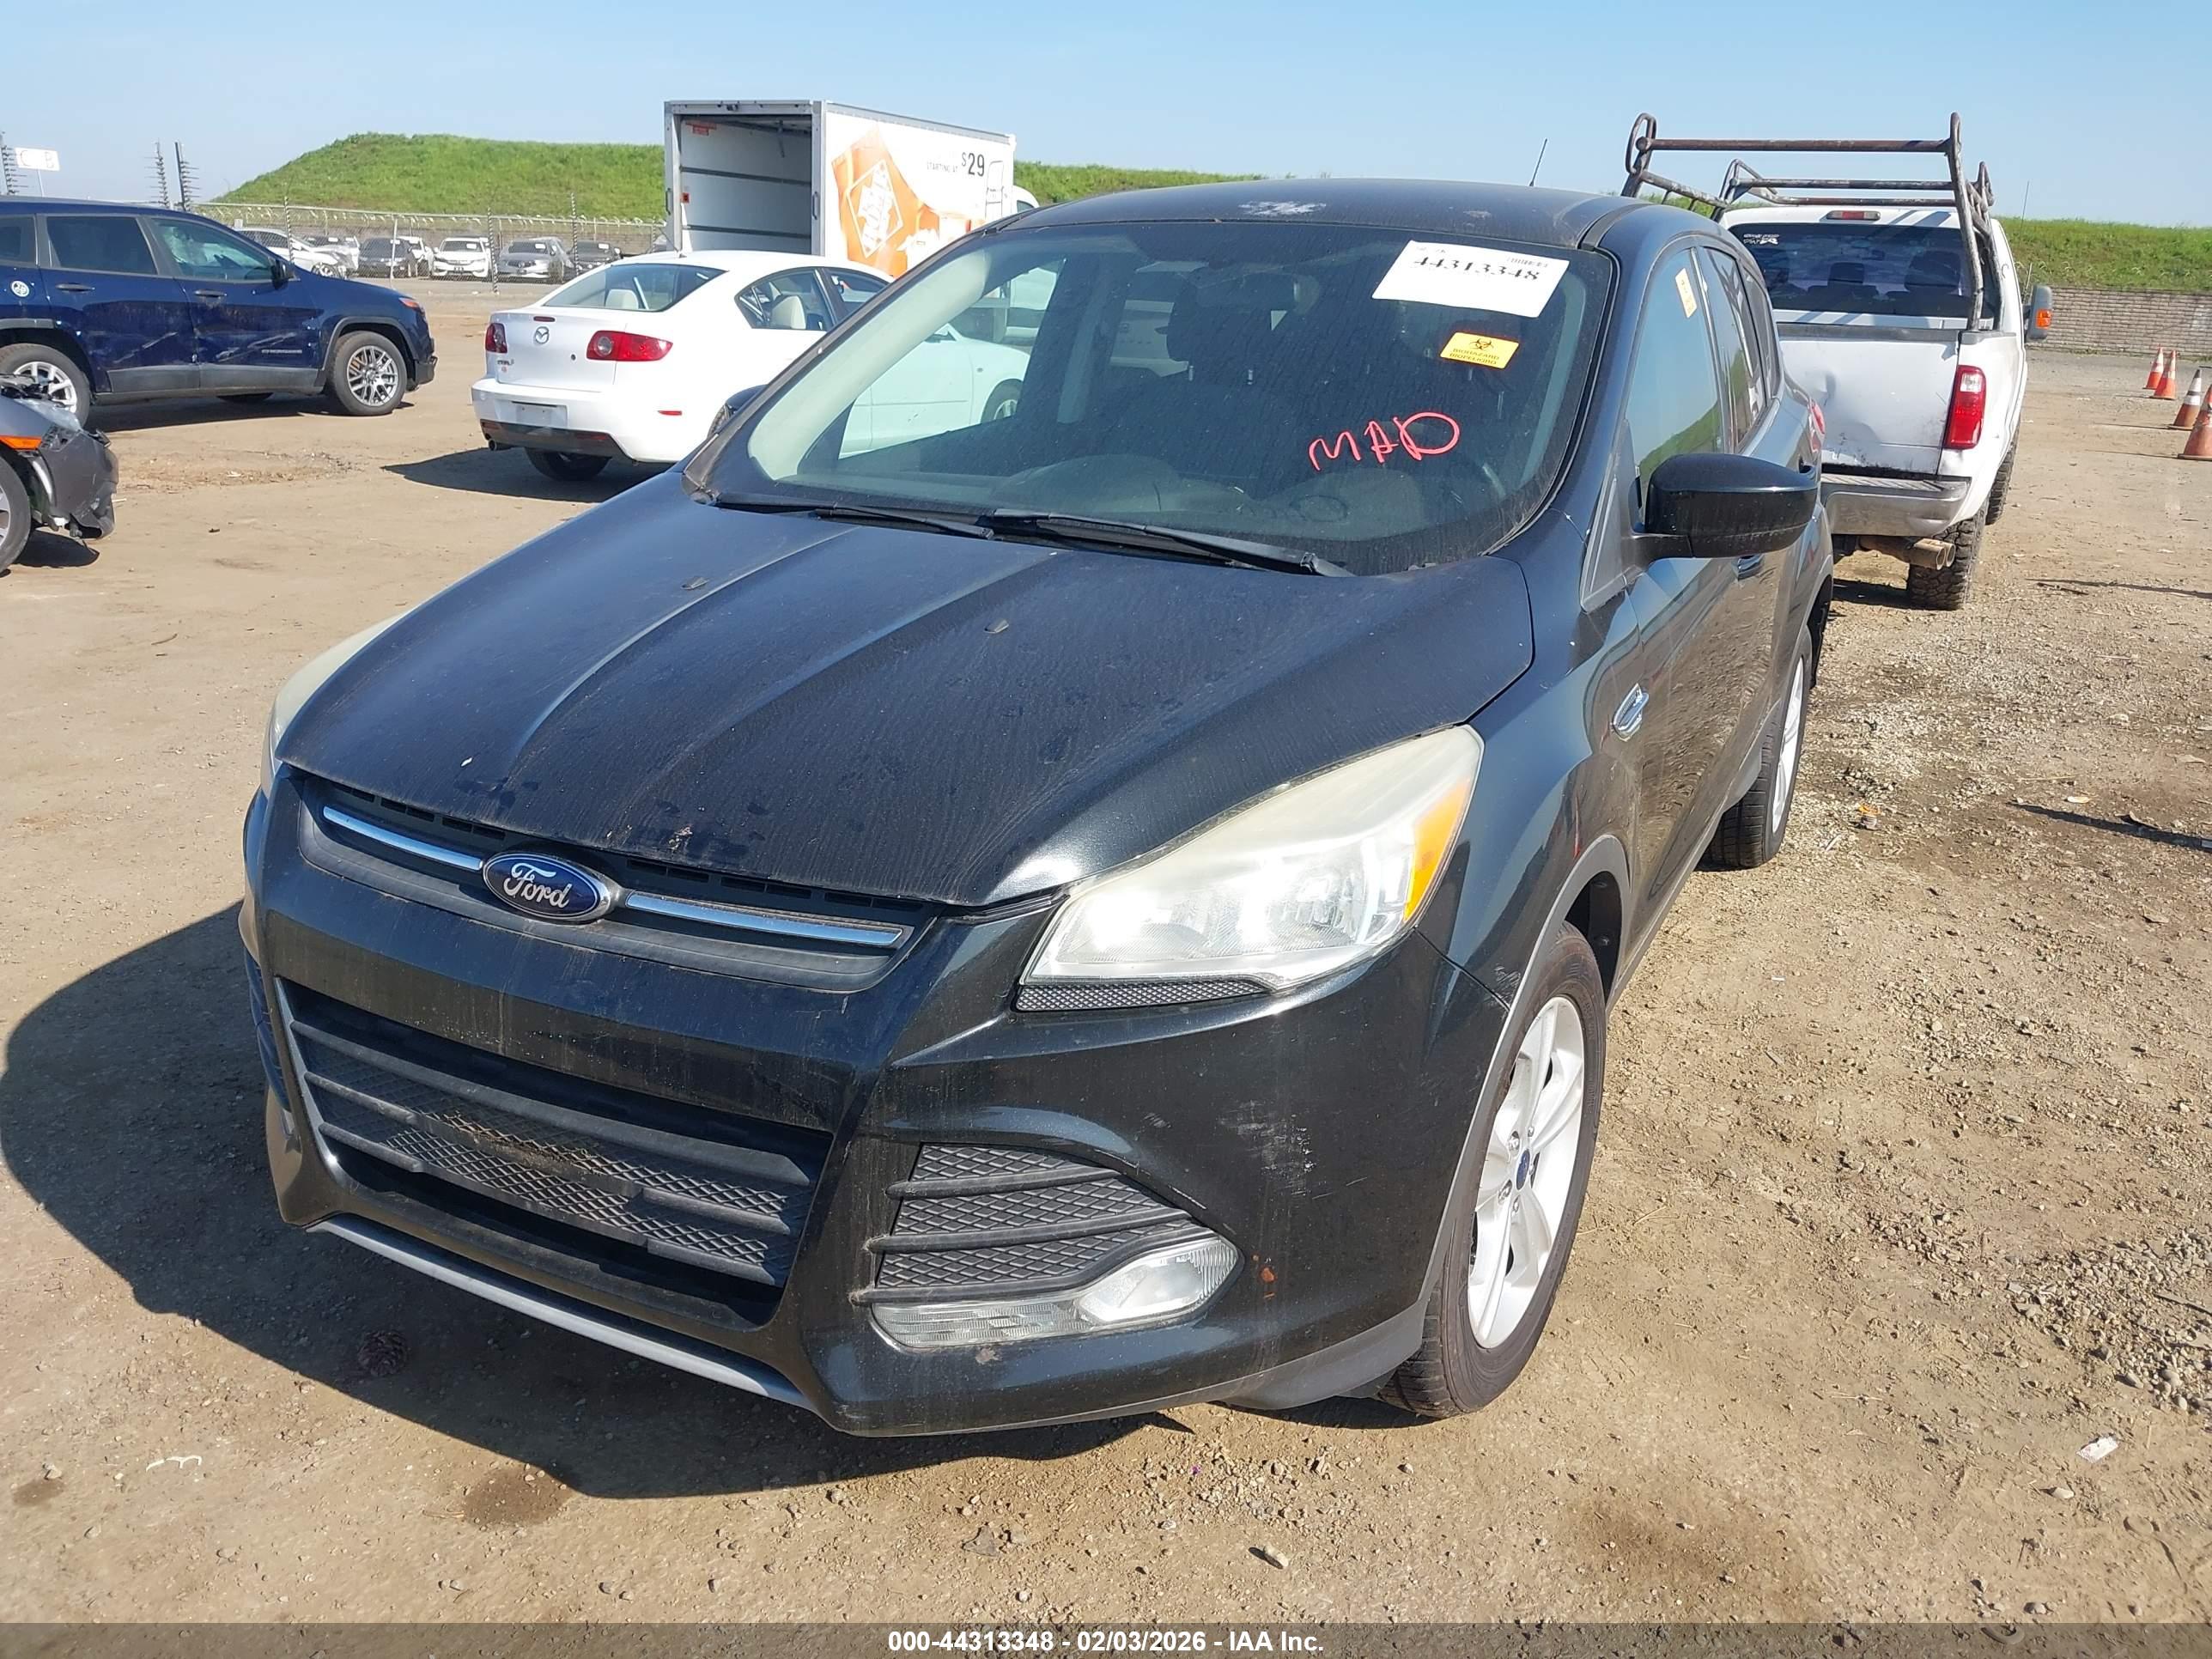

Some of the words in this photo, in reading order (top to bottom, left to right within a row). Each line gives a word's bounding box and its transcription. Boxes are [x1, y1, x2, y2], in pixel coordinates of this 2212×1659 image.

[962, 152, 985, 177] $29
[1414, 256, 1540, 281] 44313348
[1452, 348, 1500, 360] BIOHAZARD
[503, 862, 573, 908] Ford
